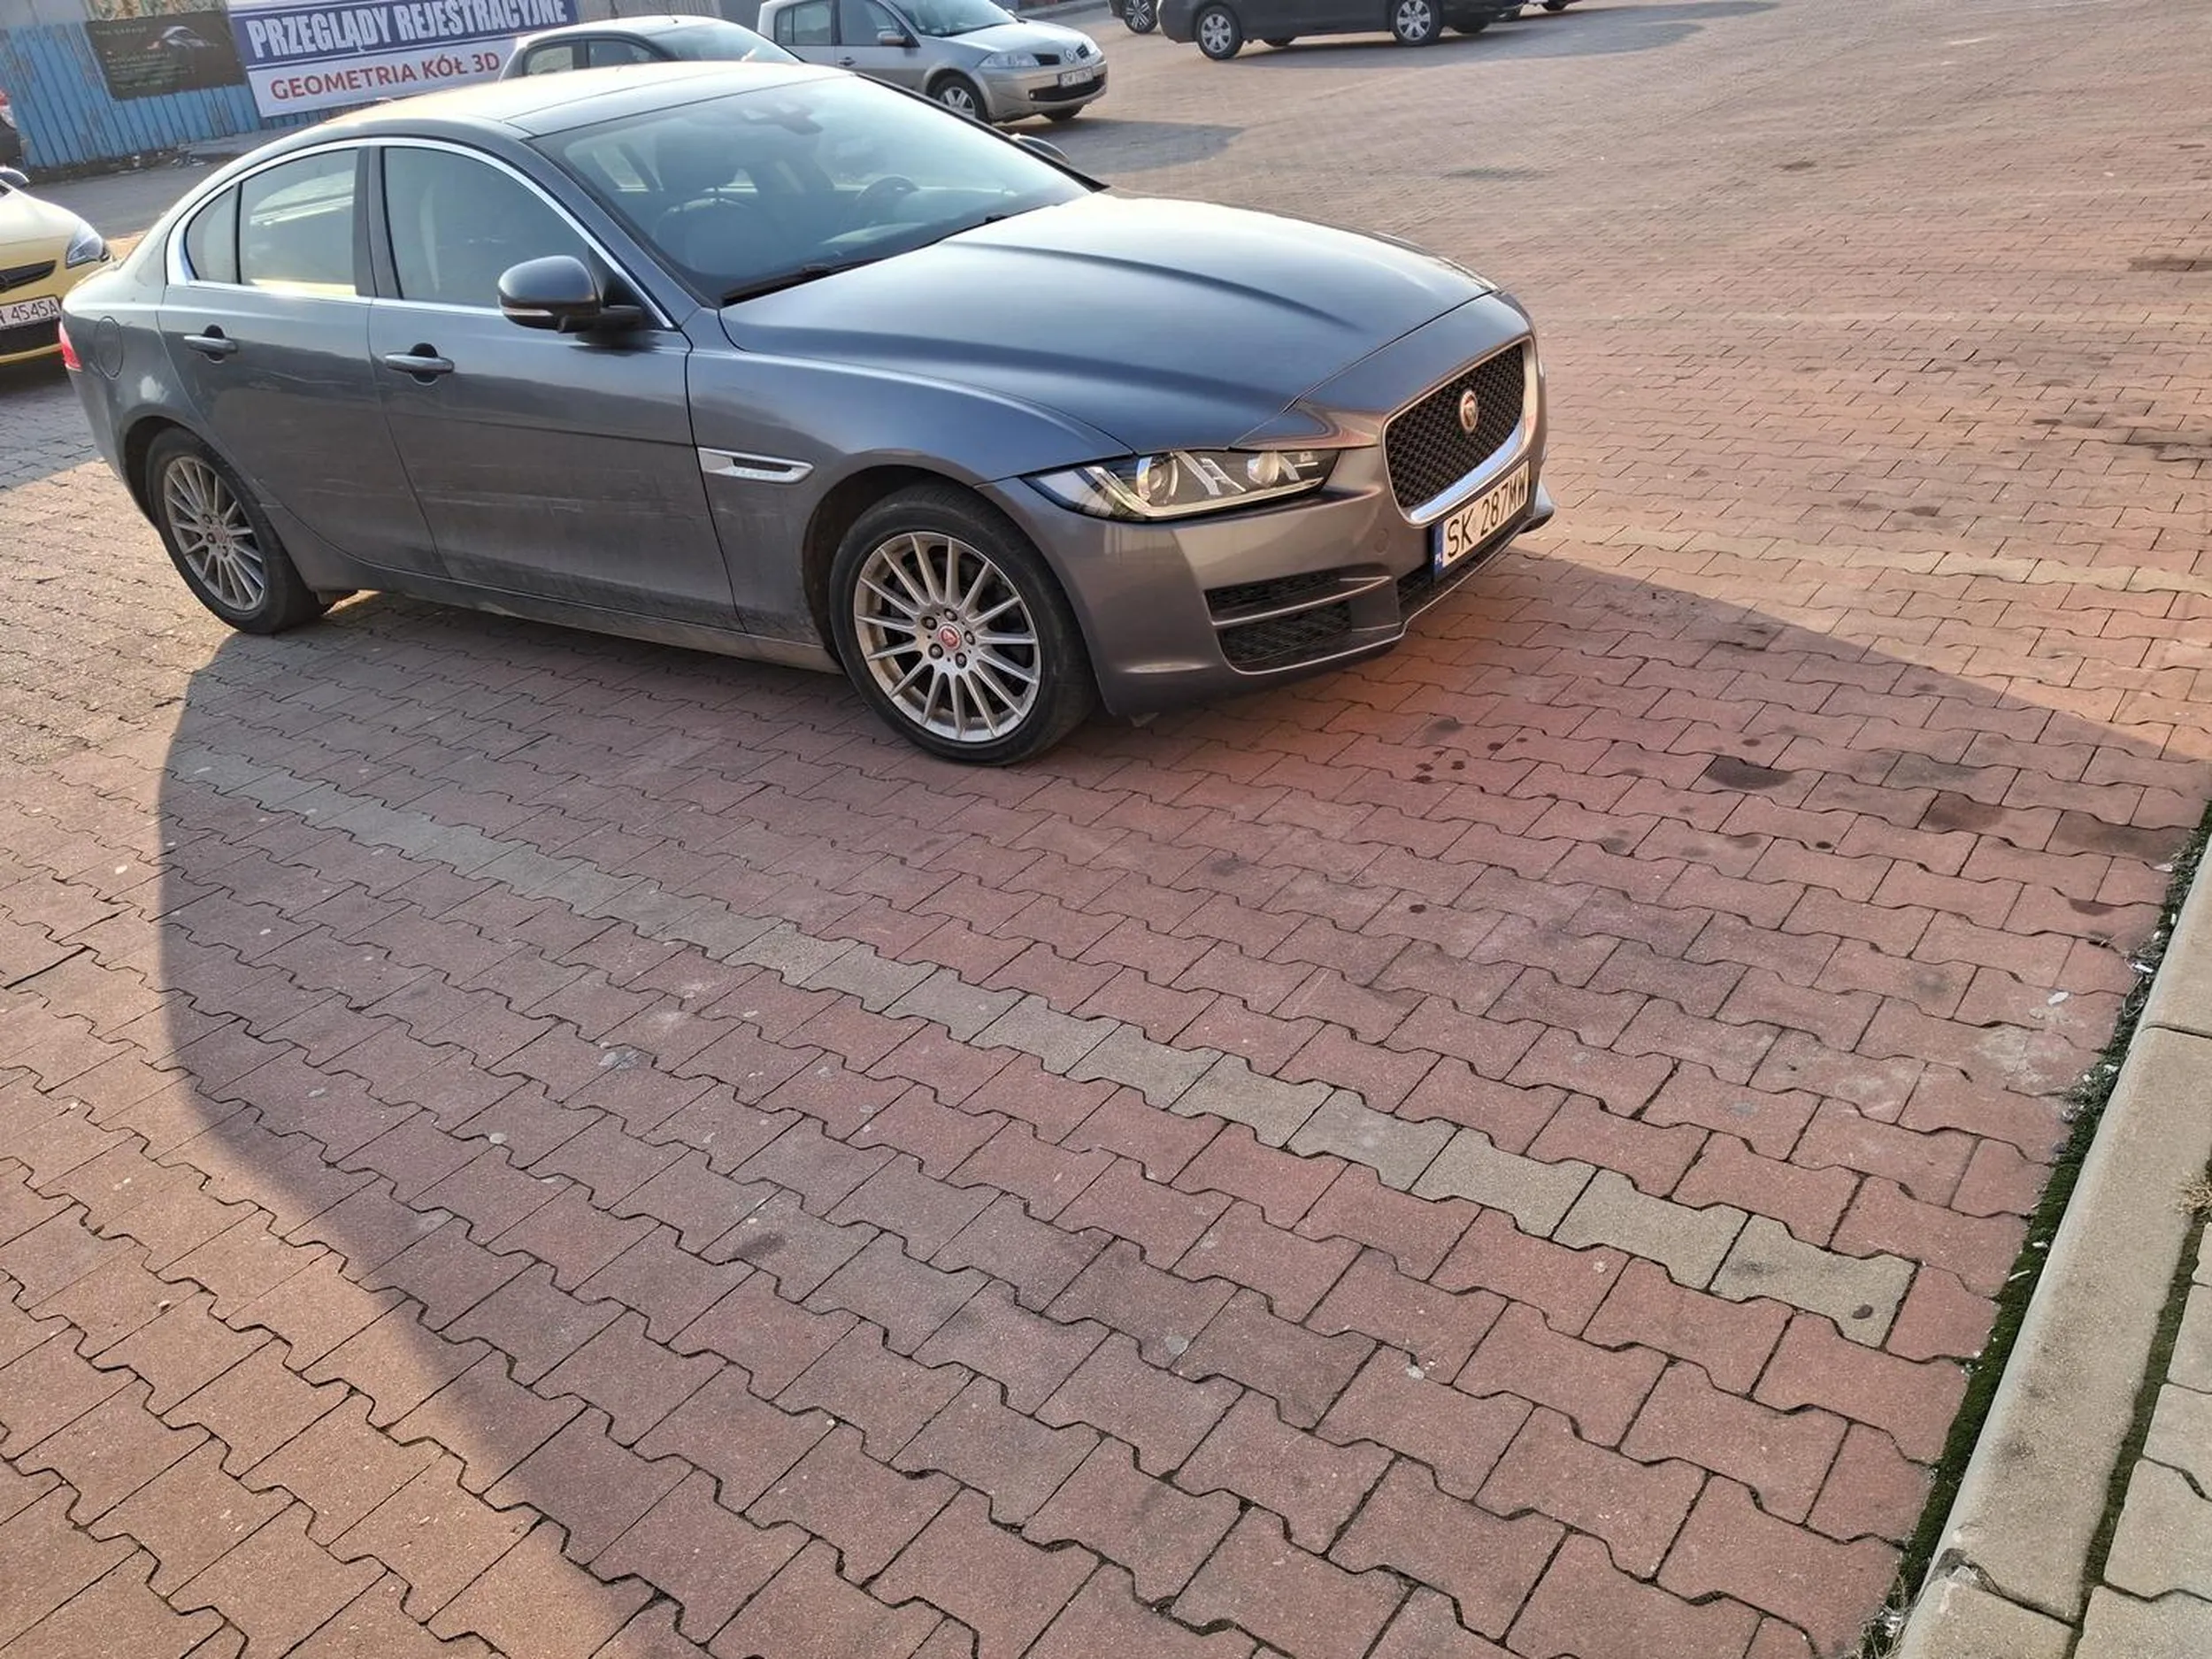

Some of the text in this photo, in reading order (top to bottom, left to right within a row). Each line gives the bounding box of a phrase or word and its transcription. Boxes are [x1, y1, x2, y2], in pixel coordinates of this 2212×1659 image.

[246, 0, 567, 58] PRZEGLĄDY REJESTRACYJNE
[271, 51, 500, 100] GEOMETRIA KÓŁ 3D
[11, 300, 58, 321] 4545A
[1448, 508, 1473, 557] SK
